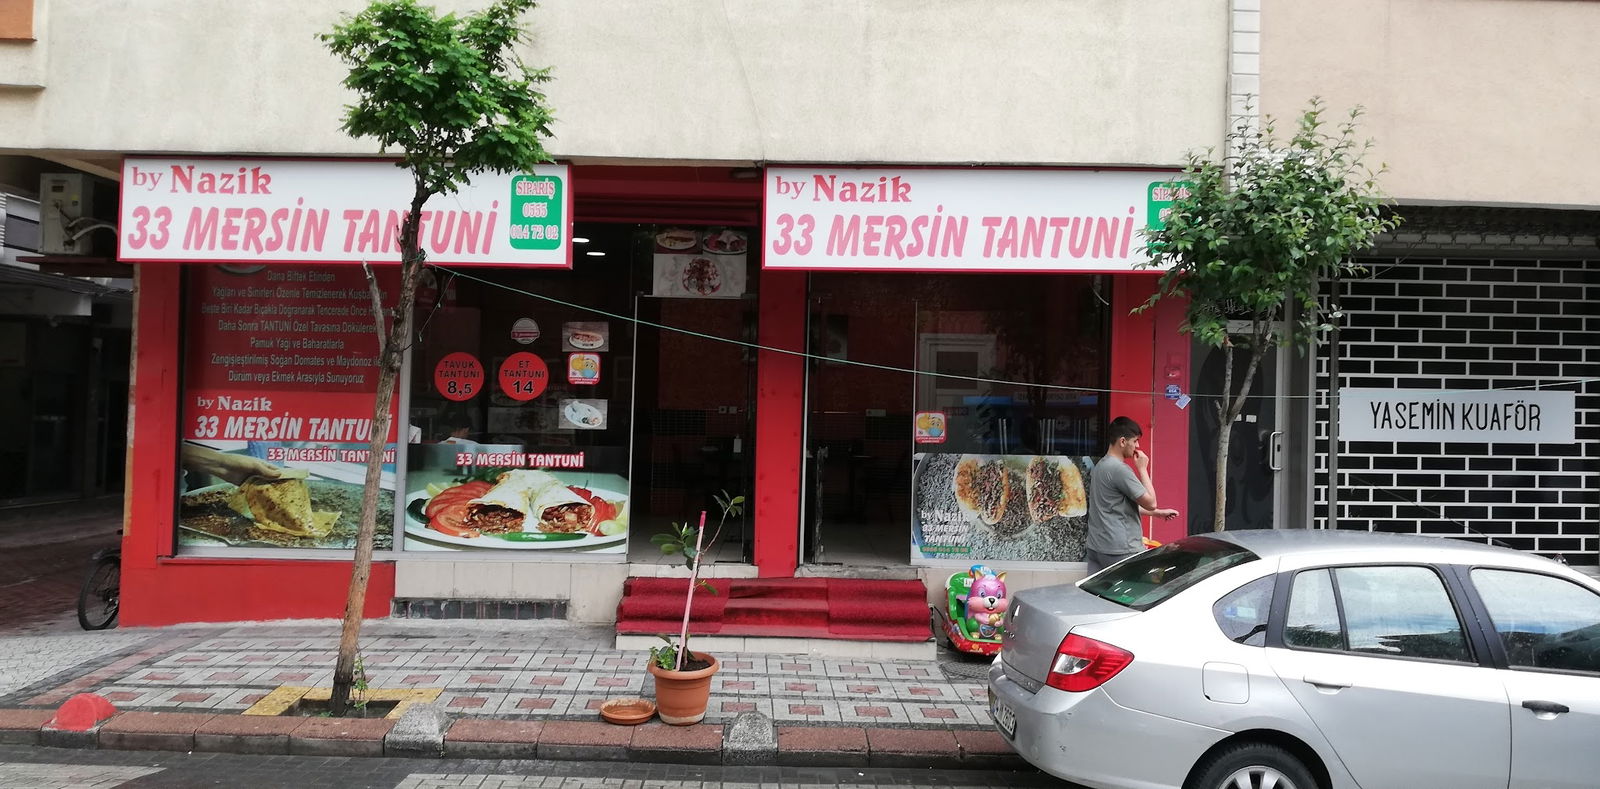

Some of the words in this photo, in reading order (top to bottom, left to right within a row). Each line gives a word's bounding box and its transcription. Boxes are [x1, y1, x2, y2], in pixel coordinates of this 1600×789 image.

[132, 167, 163, 191] by
[170, 165, 272, 195] Nazik
[516, 177, 556, 199] SİPARİŞ
[776, 176, 806, 199] by
[813, 174, 912, 203] Nazik
[522, 202, 547, 218] 0555
[128, 206, 172, 250] 33
[183, 197, 330, 255] MERSİN
[531, 225, 544, 239] 72
[773, 213, 815, 256] 33
[826, 204, 969, 260] MERSİN
[982, 206, 1135, 259] TANTUNİ
[218, 319, 236, 330] Daha
[238, 320, 258, 331] Sonra
[250, 337, 273, 348] Pamuk
[293, 340, 301, 348] ve
[294, 354, 325, 366] Domates
[327, 358, 335, 366] ve
[444, 360, 474, 368] TAVUK
[518, 360, 531, 368] ET
[254, 373, 270, 384] veya
[272, 371, 295, 382] Ekmek
[447, 381, 472, 396] 8,5
[513, 380, 534, 394] 14
[197, 396, 214, 409] by
[217, 396, 272, 411] Nazik
[1370, 398, 1455, 430] YASEMİN
[1462, 400, 1541, 431] KUAFÖR
[195, 415, 219, 438] 33
[224, 411, 303, 440] MERSİN
[309, 414, 392, 440] TANTUİ
[268, 447, 282, 461] 33
[286, 446, 337, 462] MERSİN
[340, 448, 395, 464] TANTNİ
[456, 452, 473, 467] 33
[476, 450, 526, 467] MERSİN
[528, 451, 584, 467] TANTUNİ
